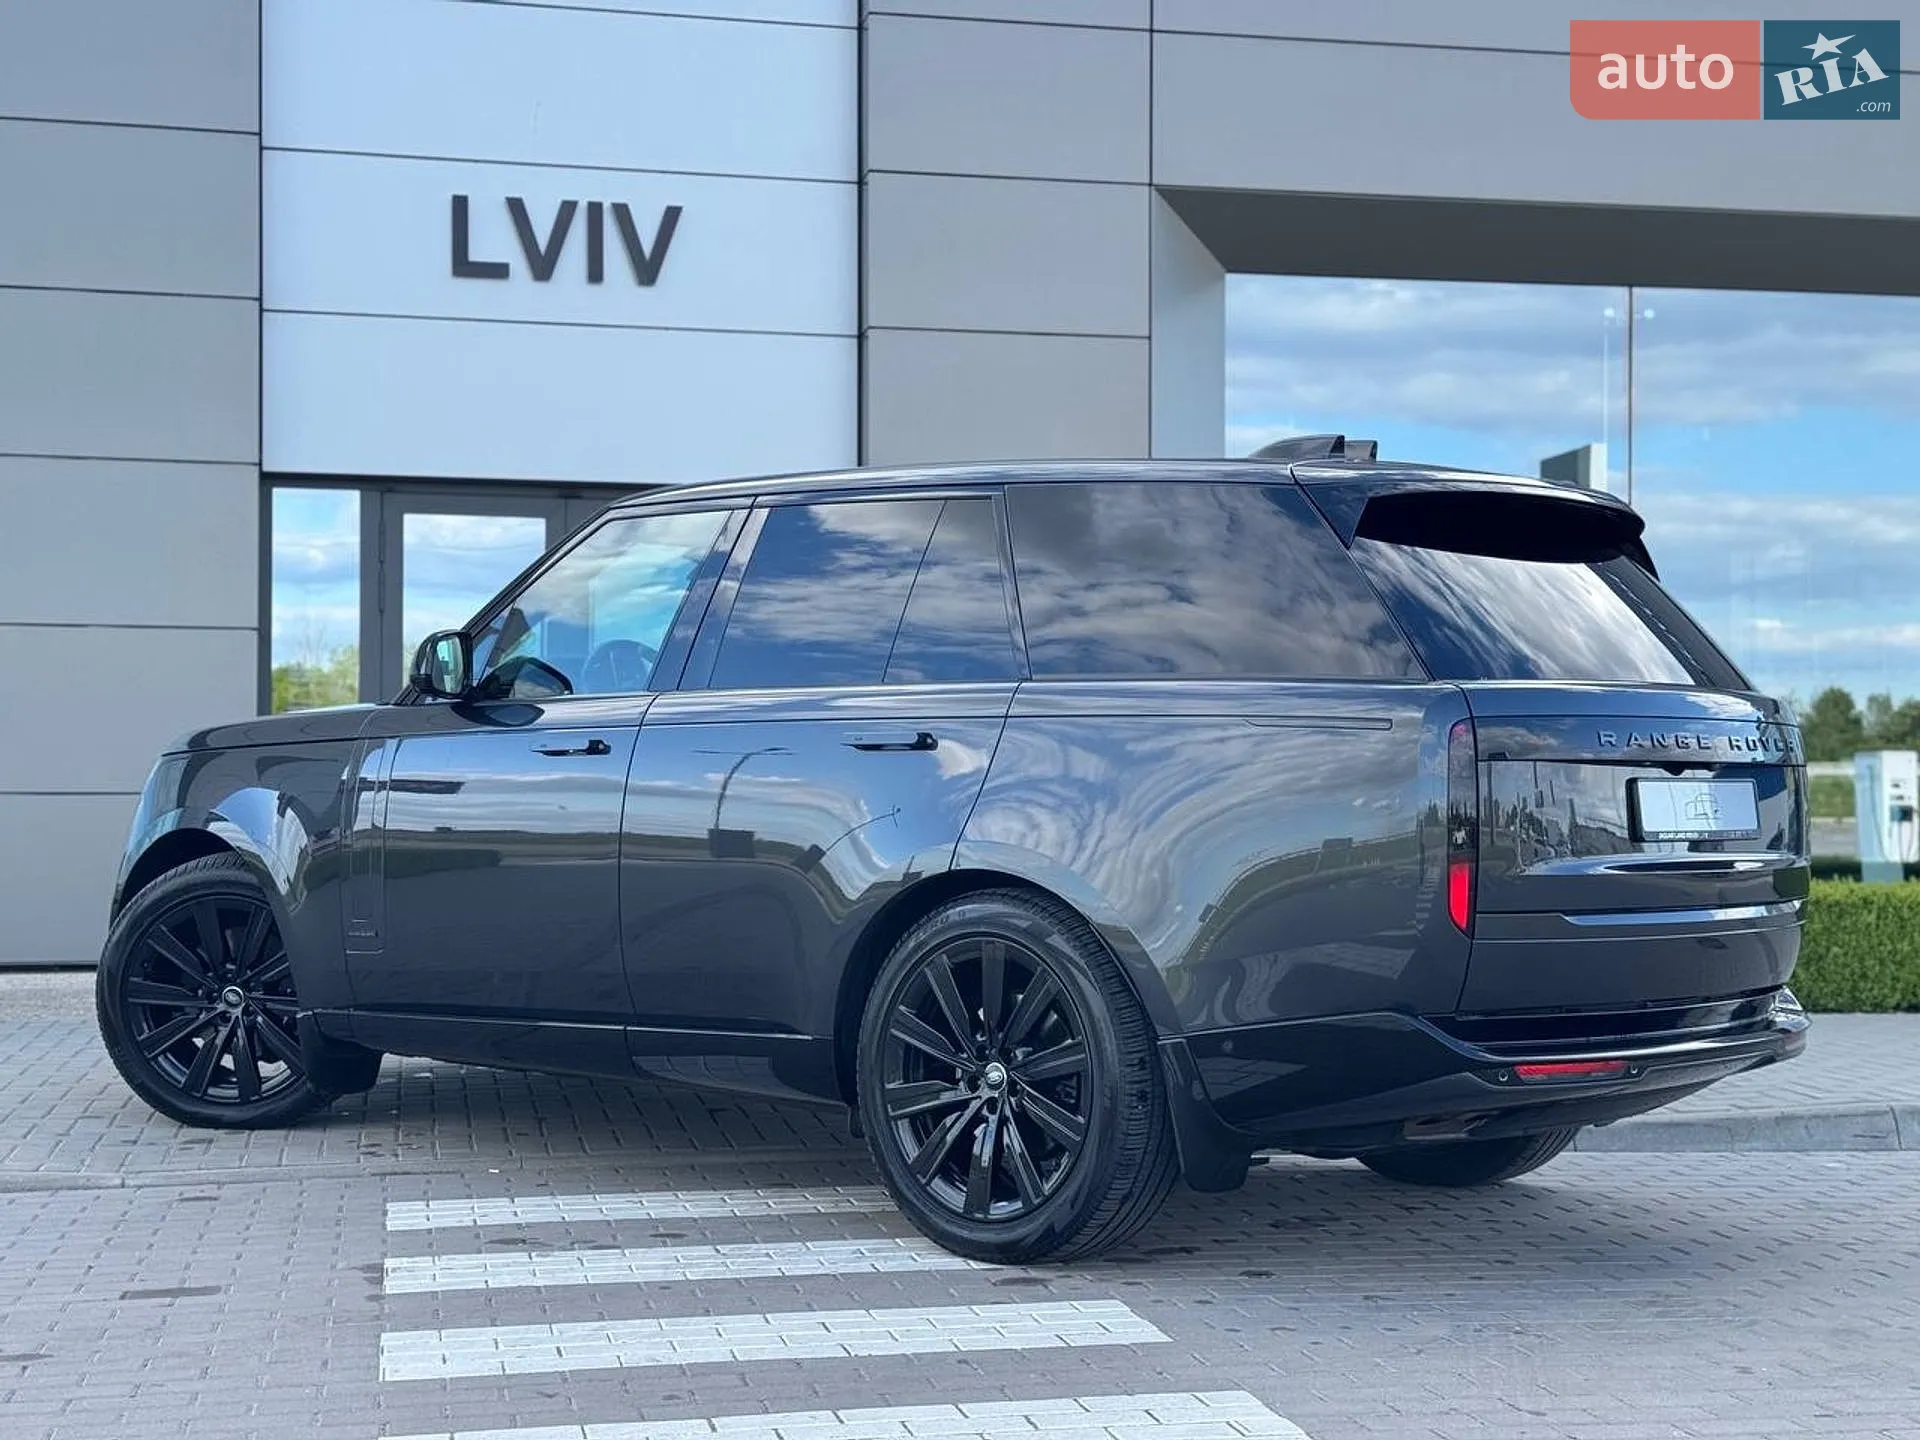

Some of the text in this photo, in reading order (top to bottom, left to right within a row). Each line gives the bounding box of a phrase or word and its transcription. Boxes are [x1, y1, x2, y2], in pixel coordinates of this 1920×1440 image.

[451, 194, 684, 287] LVIV
[1597, 730, 1795, 753] RANGE ROVER
